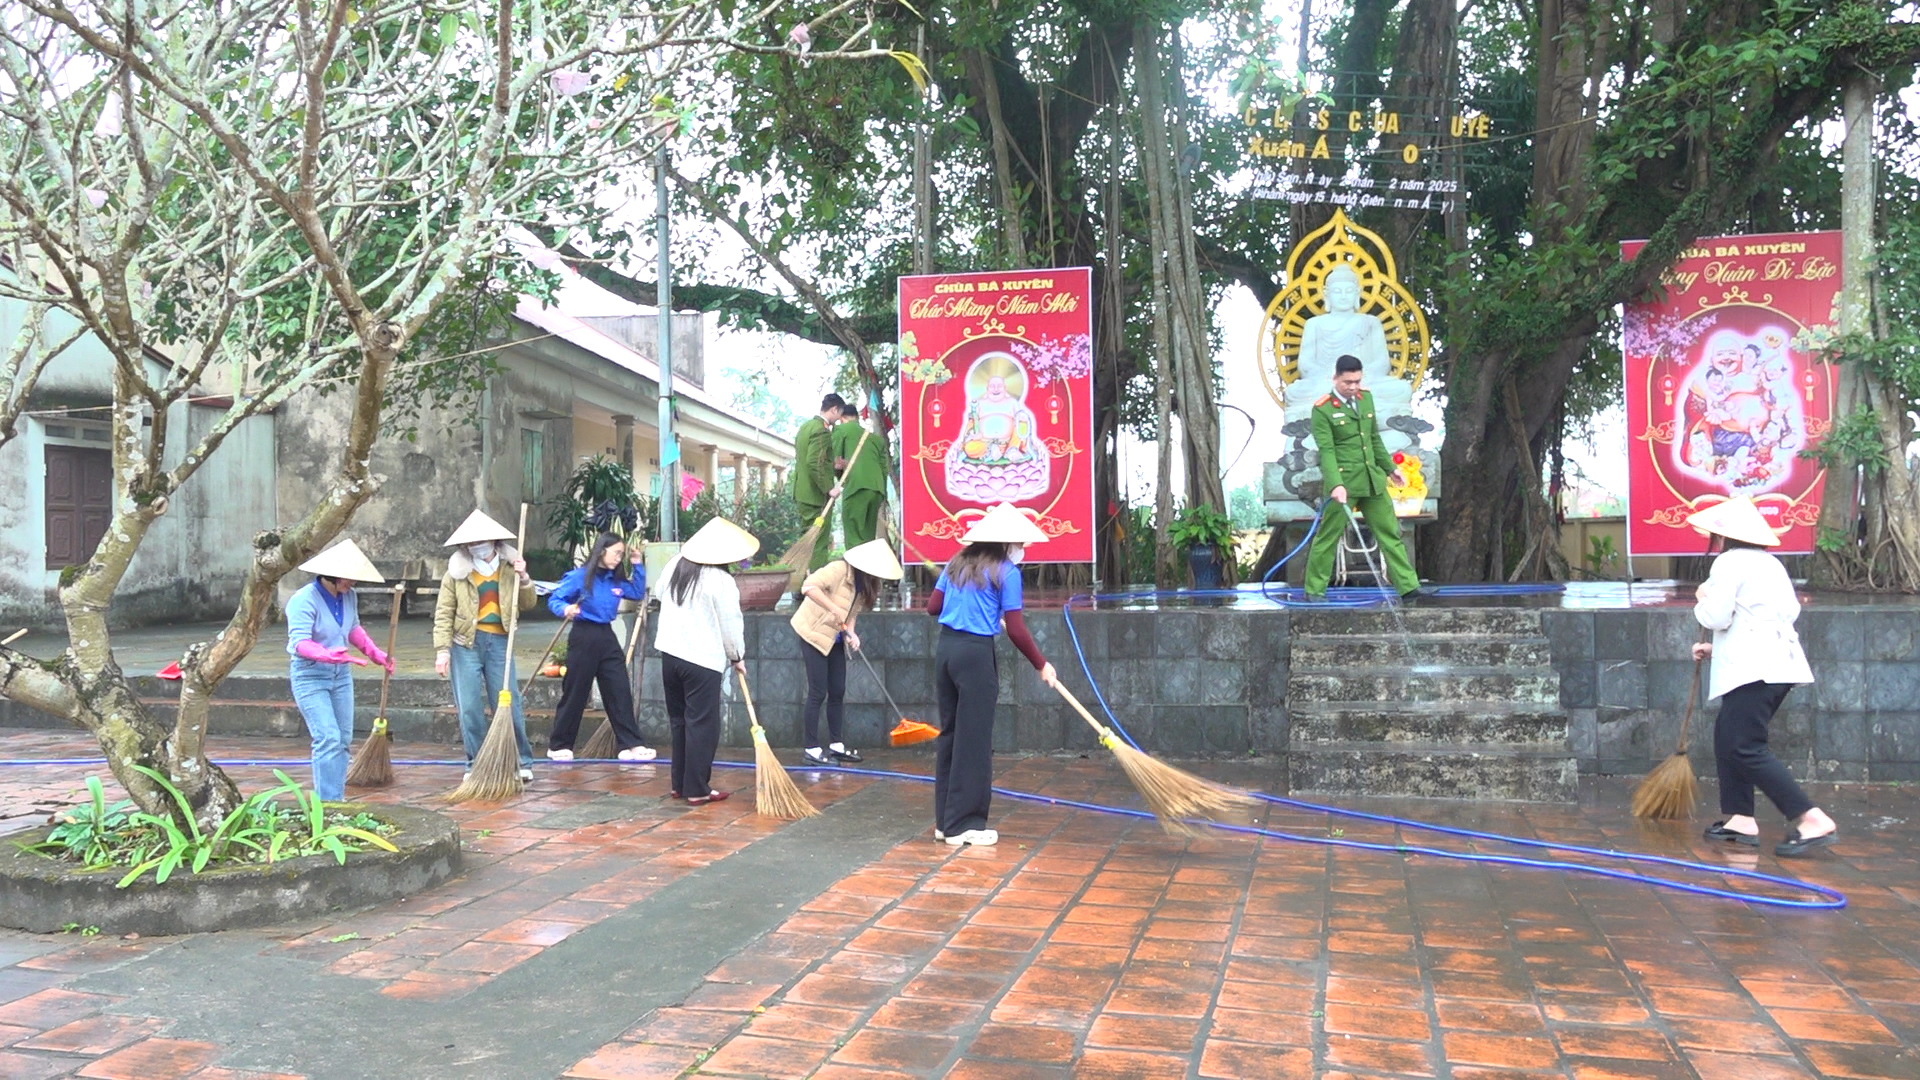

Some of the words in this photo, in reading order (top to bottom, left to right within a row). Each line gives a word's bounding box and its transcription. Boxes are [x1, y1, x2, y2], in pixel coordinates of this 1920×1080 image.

[1247, 136, 1306, 159] Xuân
[1399, 179, 1425, 191] năm
[1427, 180, 1458, 193] 2025
[1286, 191, 1313, 206] ngày
[1314, 191, 1326, 203] 15
[1744, 240, 1806, 256] XUYÊN
[1703, 260, 1758, 287] Xuân
[934, 281, 975, 295] CHÙA
[1002, 278, 1054, 291] XUYÊN
[909, 294, 944, 320] Chúc
[944, 296, 995, 326] Mừng
[996, 294, 1041, 316] Năm
[1040, 292, 1080, 315] Mới
